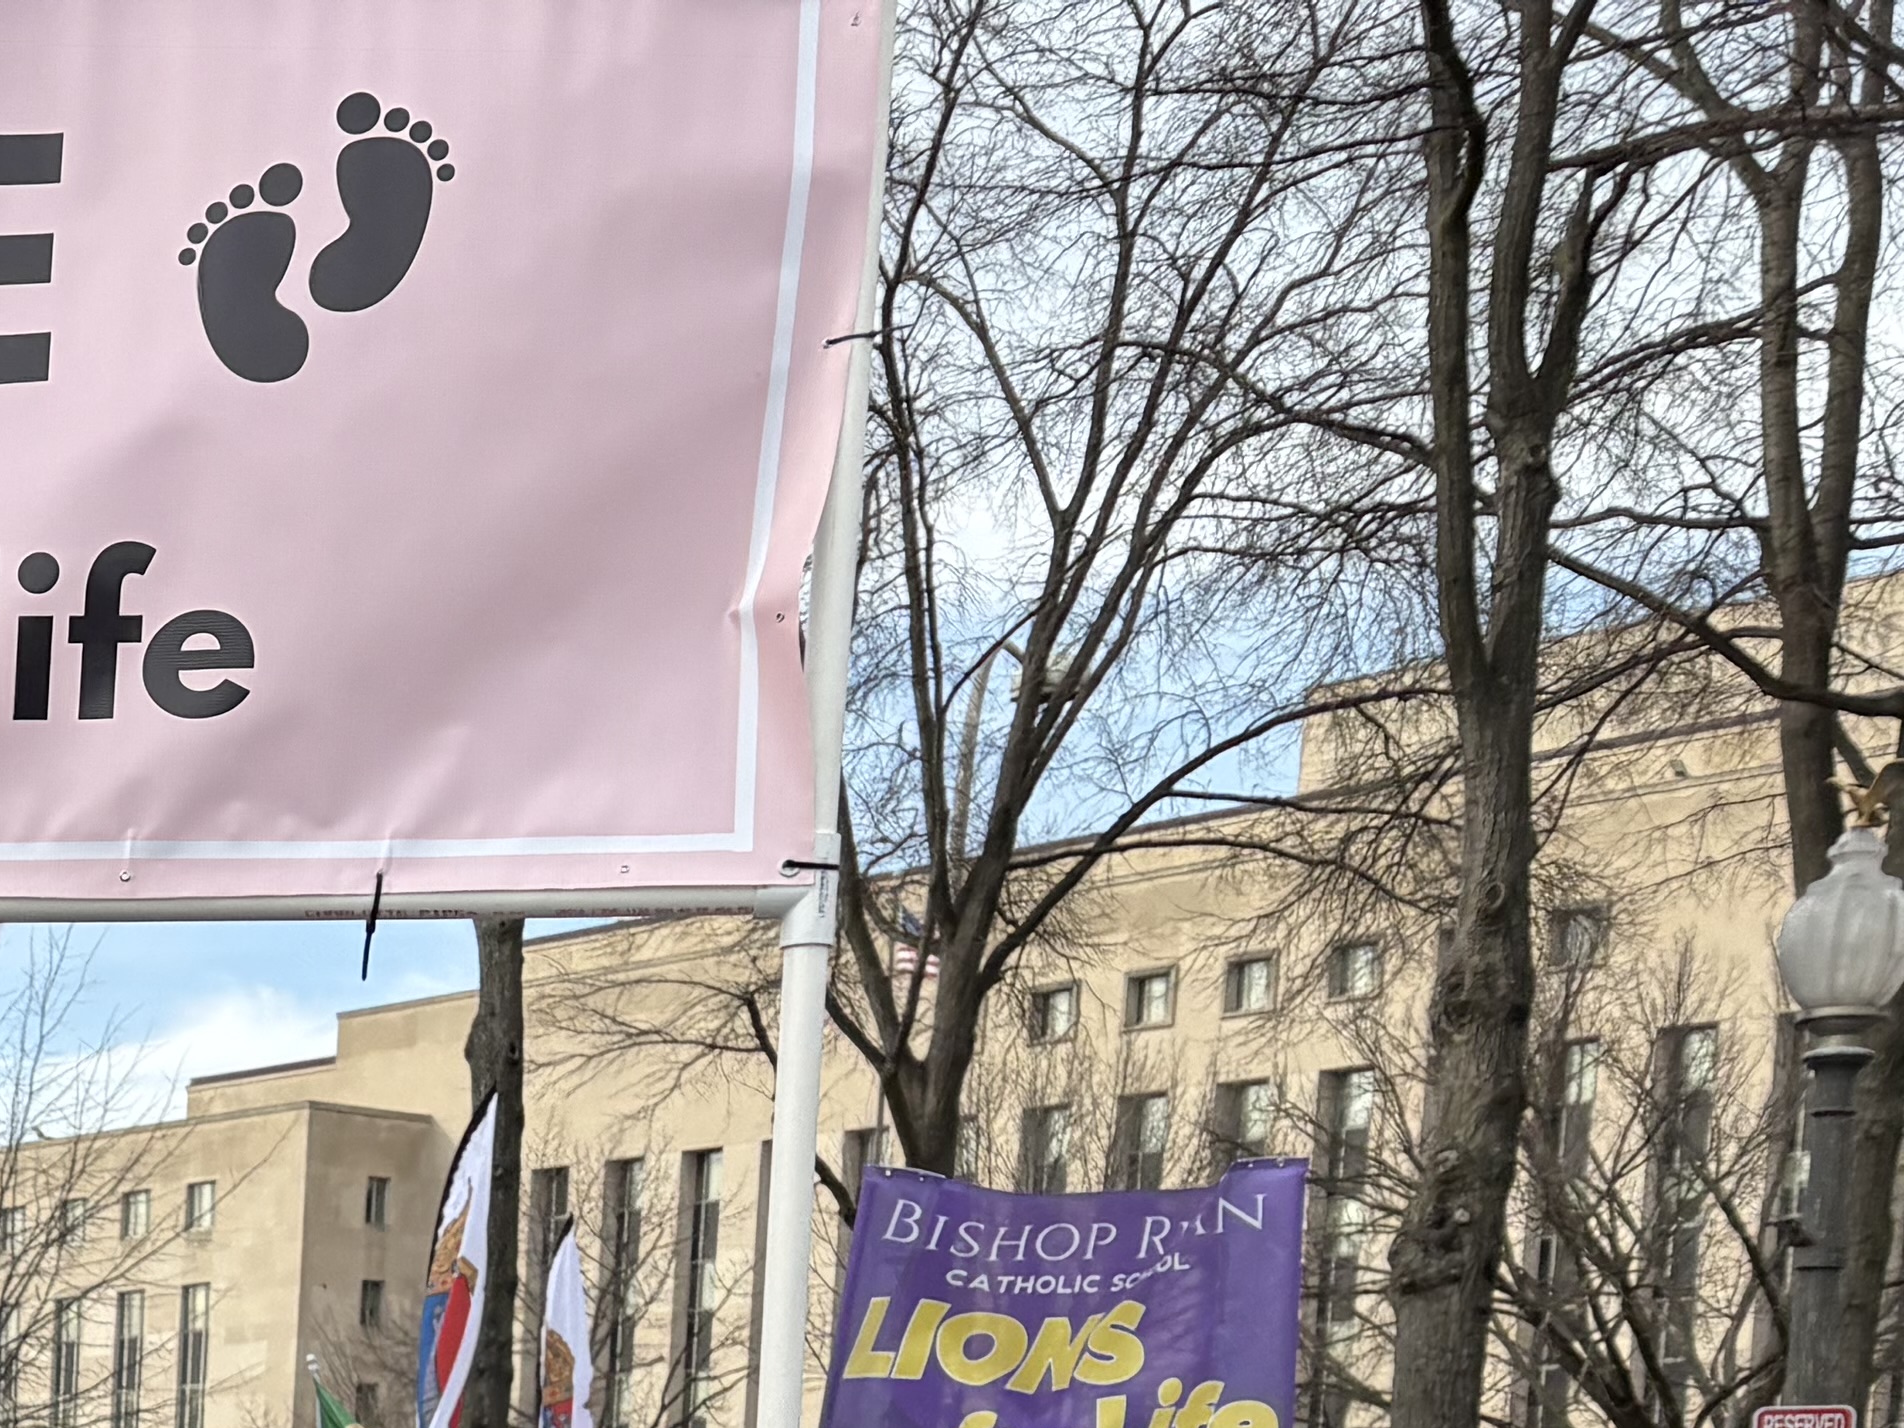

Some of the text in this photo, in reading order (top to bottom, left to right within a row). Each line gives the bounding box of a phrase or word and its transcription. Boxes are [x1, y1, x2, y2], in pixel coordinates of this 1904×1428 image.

[882, 1192, 1268, 1264] BISHOP RN
[945, 1266, 1101, 1296] CATHOLIC
[842, 1295, 1147, 1396] LIONS
